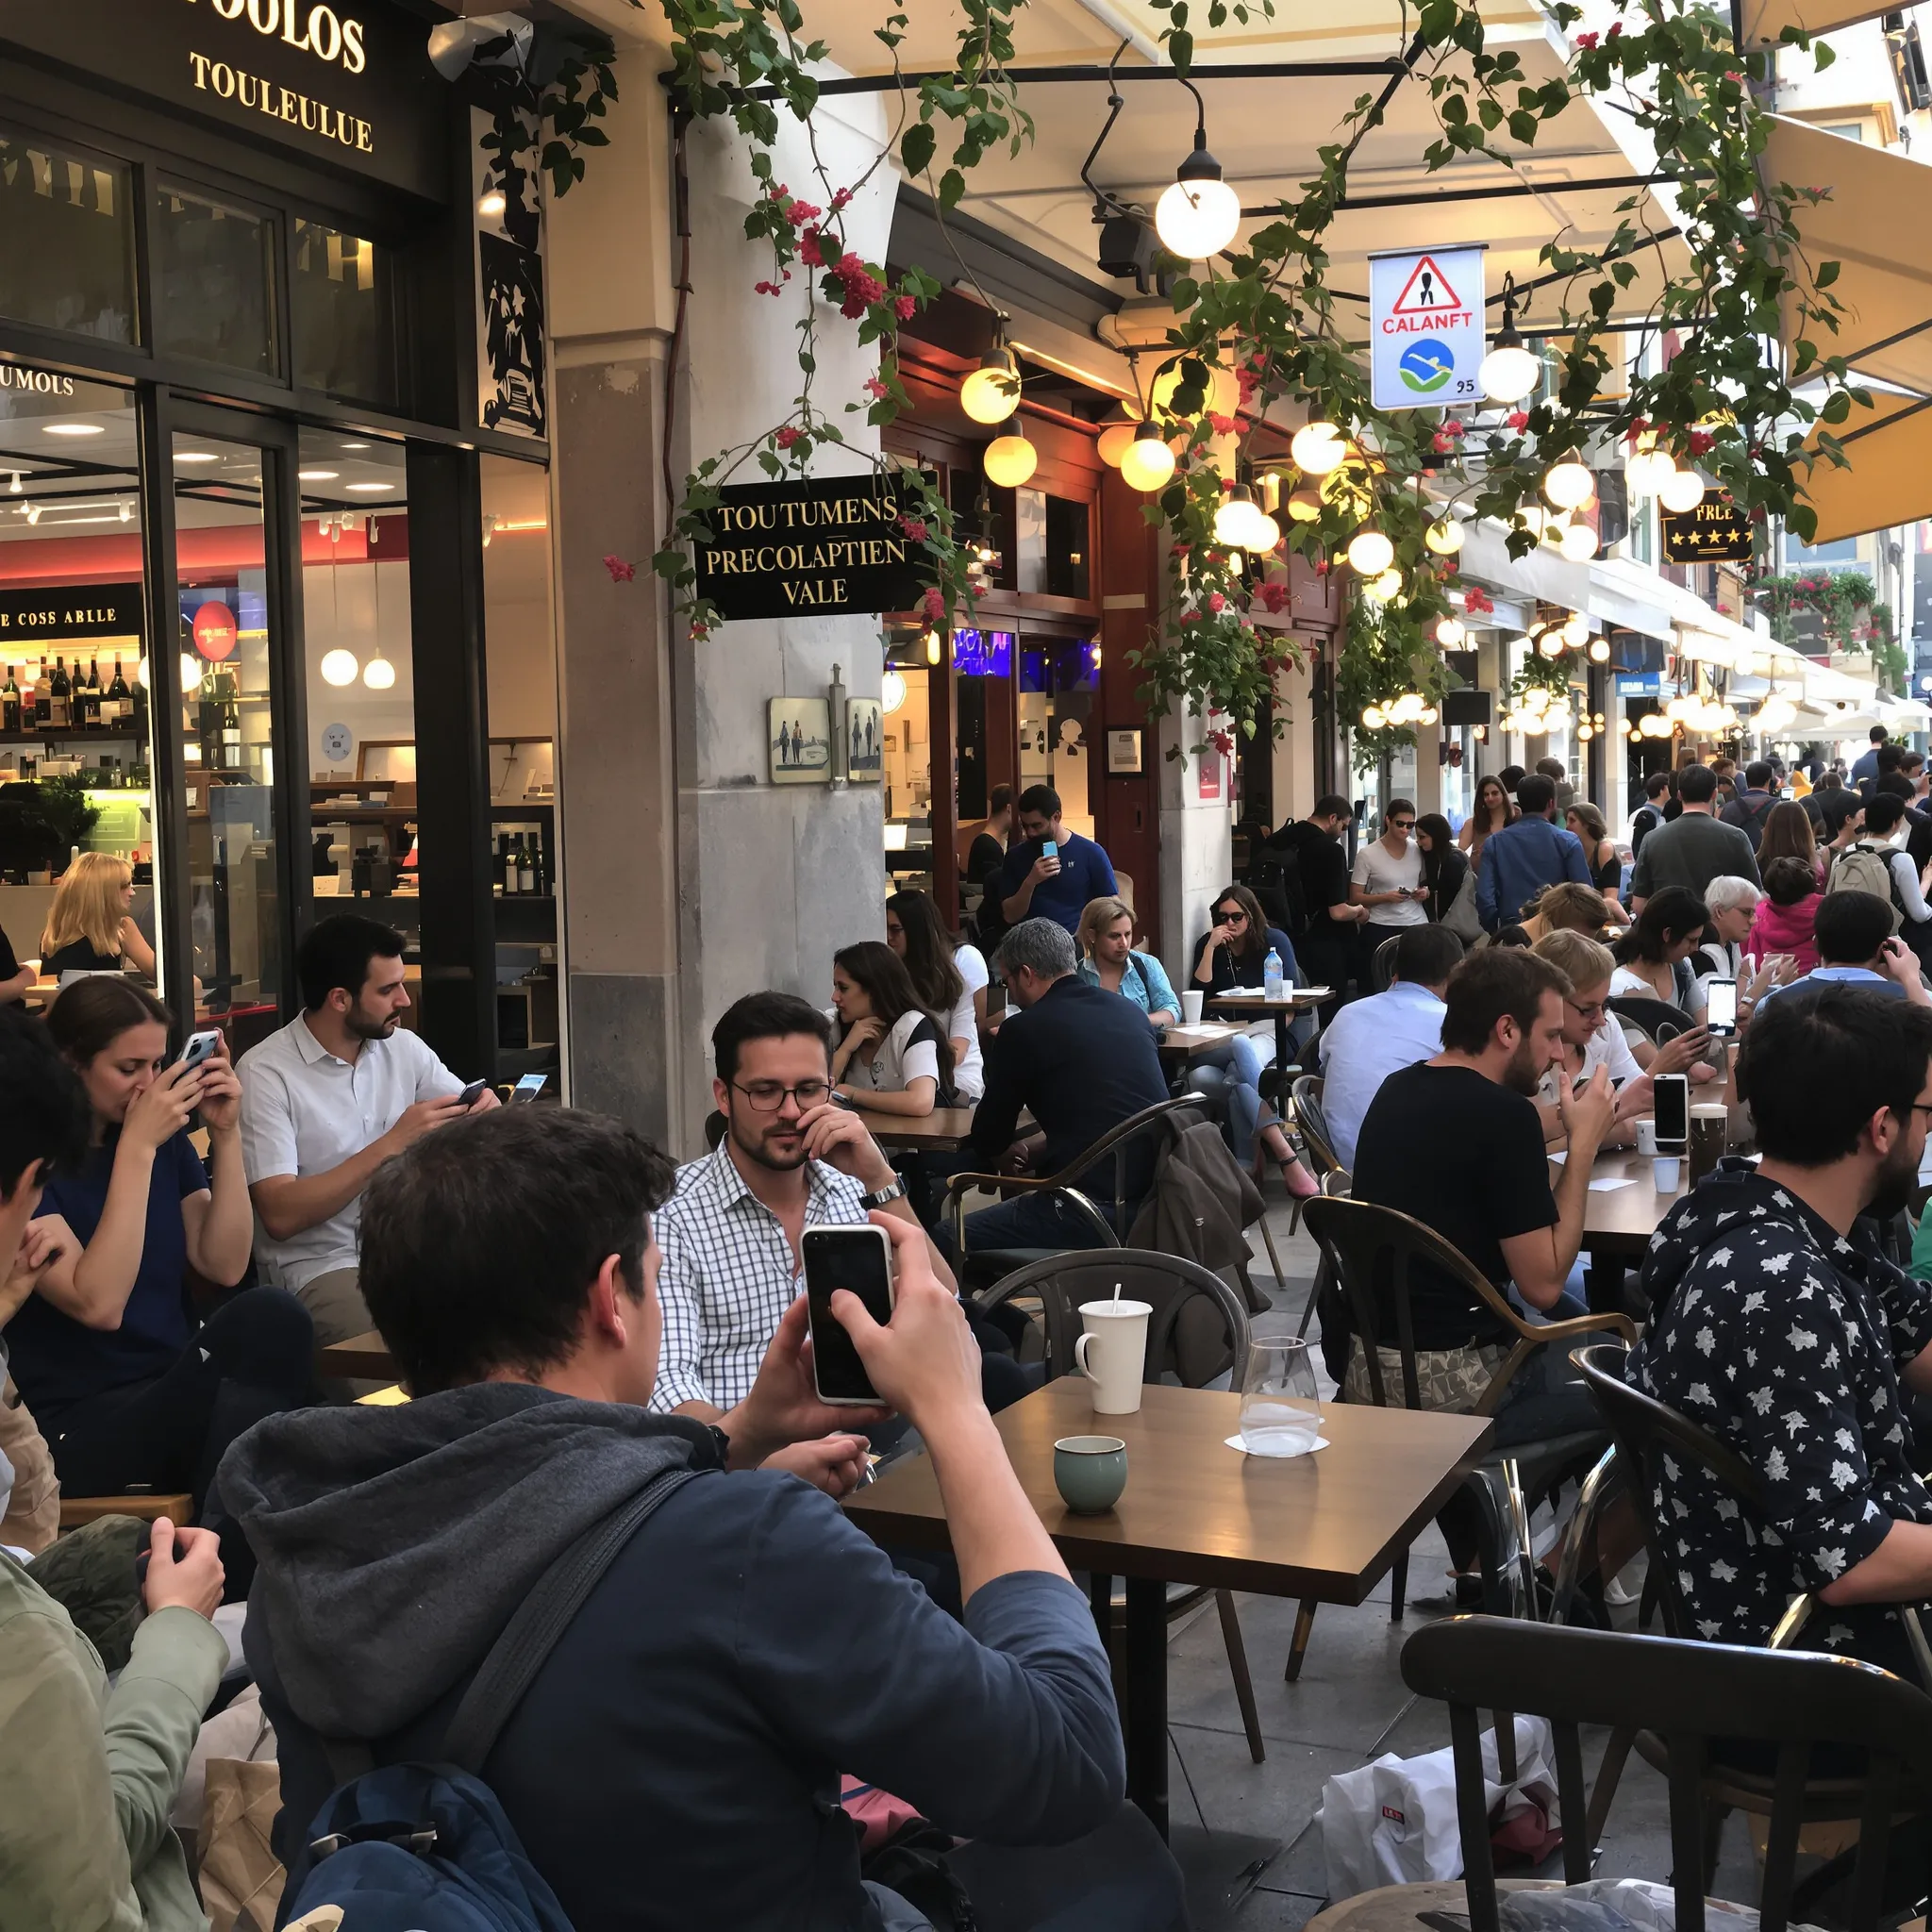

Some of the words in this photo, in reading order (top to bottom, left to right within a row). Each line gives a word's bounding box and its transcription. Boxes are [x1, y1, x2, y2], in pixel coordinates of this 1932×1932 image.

[190, 51, 373, 153] TOULEULUE
[1382, 312, 1473, 334] CALANFT
[1457, 379, 1474, 393] 95
[781, 578, 849, 606] VALE
[18, 611, 57, 626] COSS
